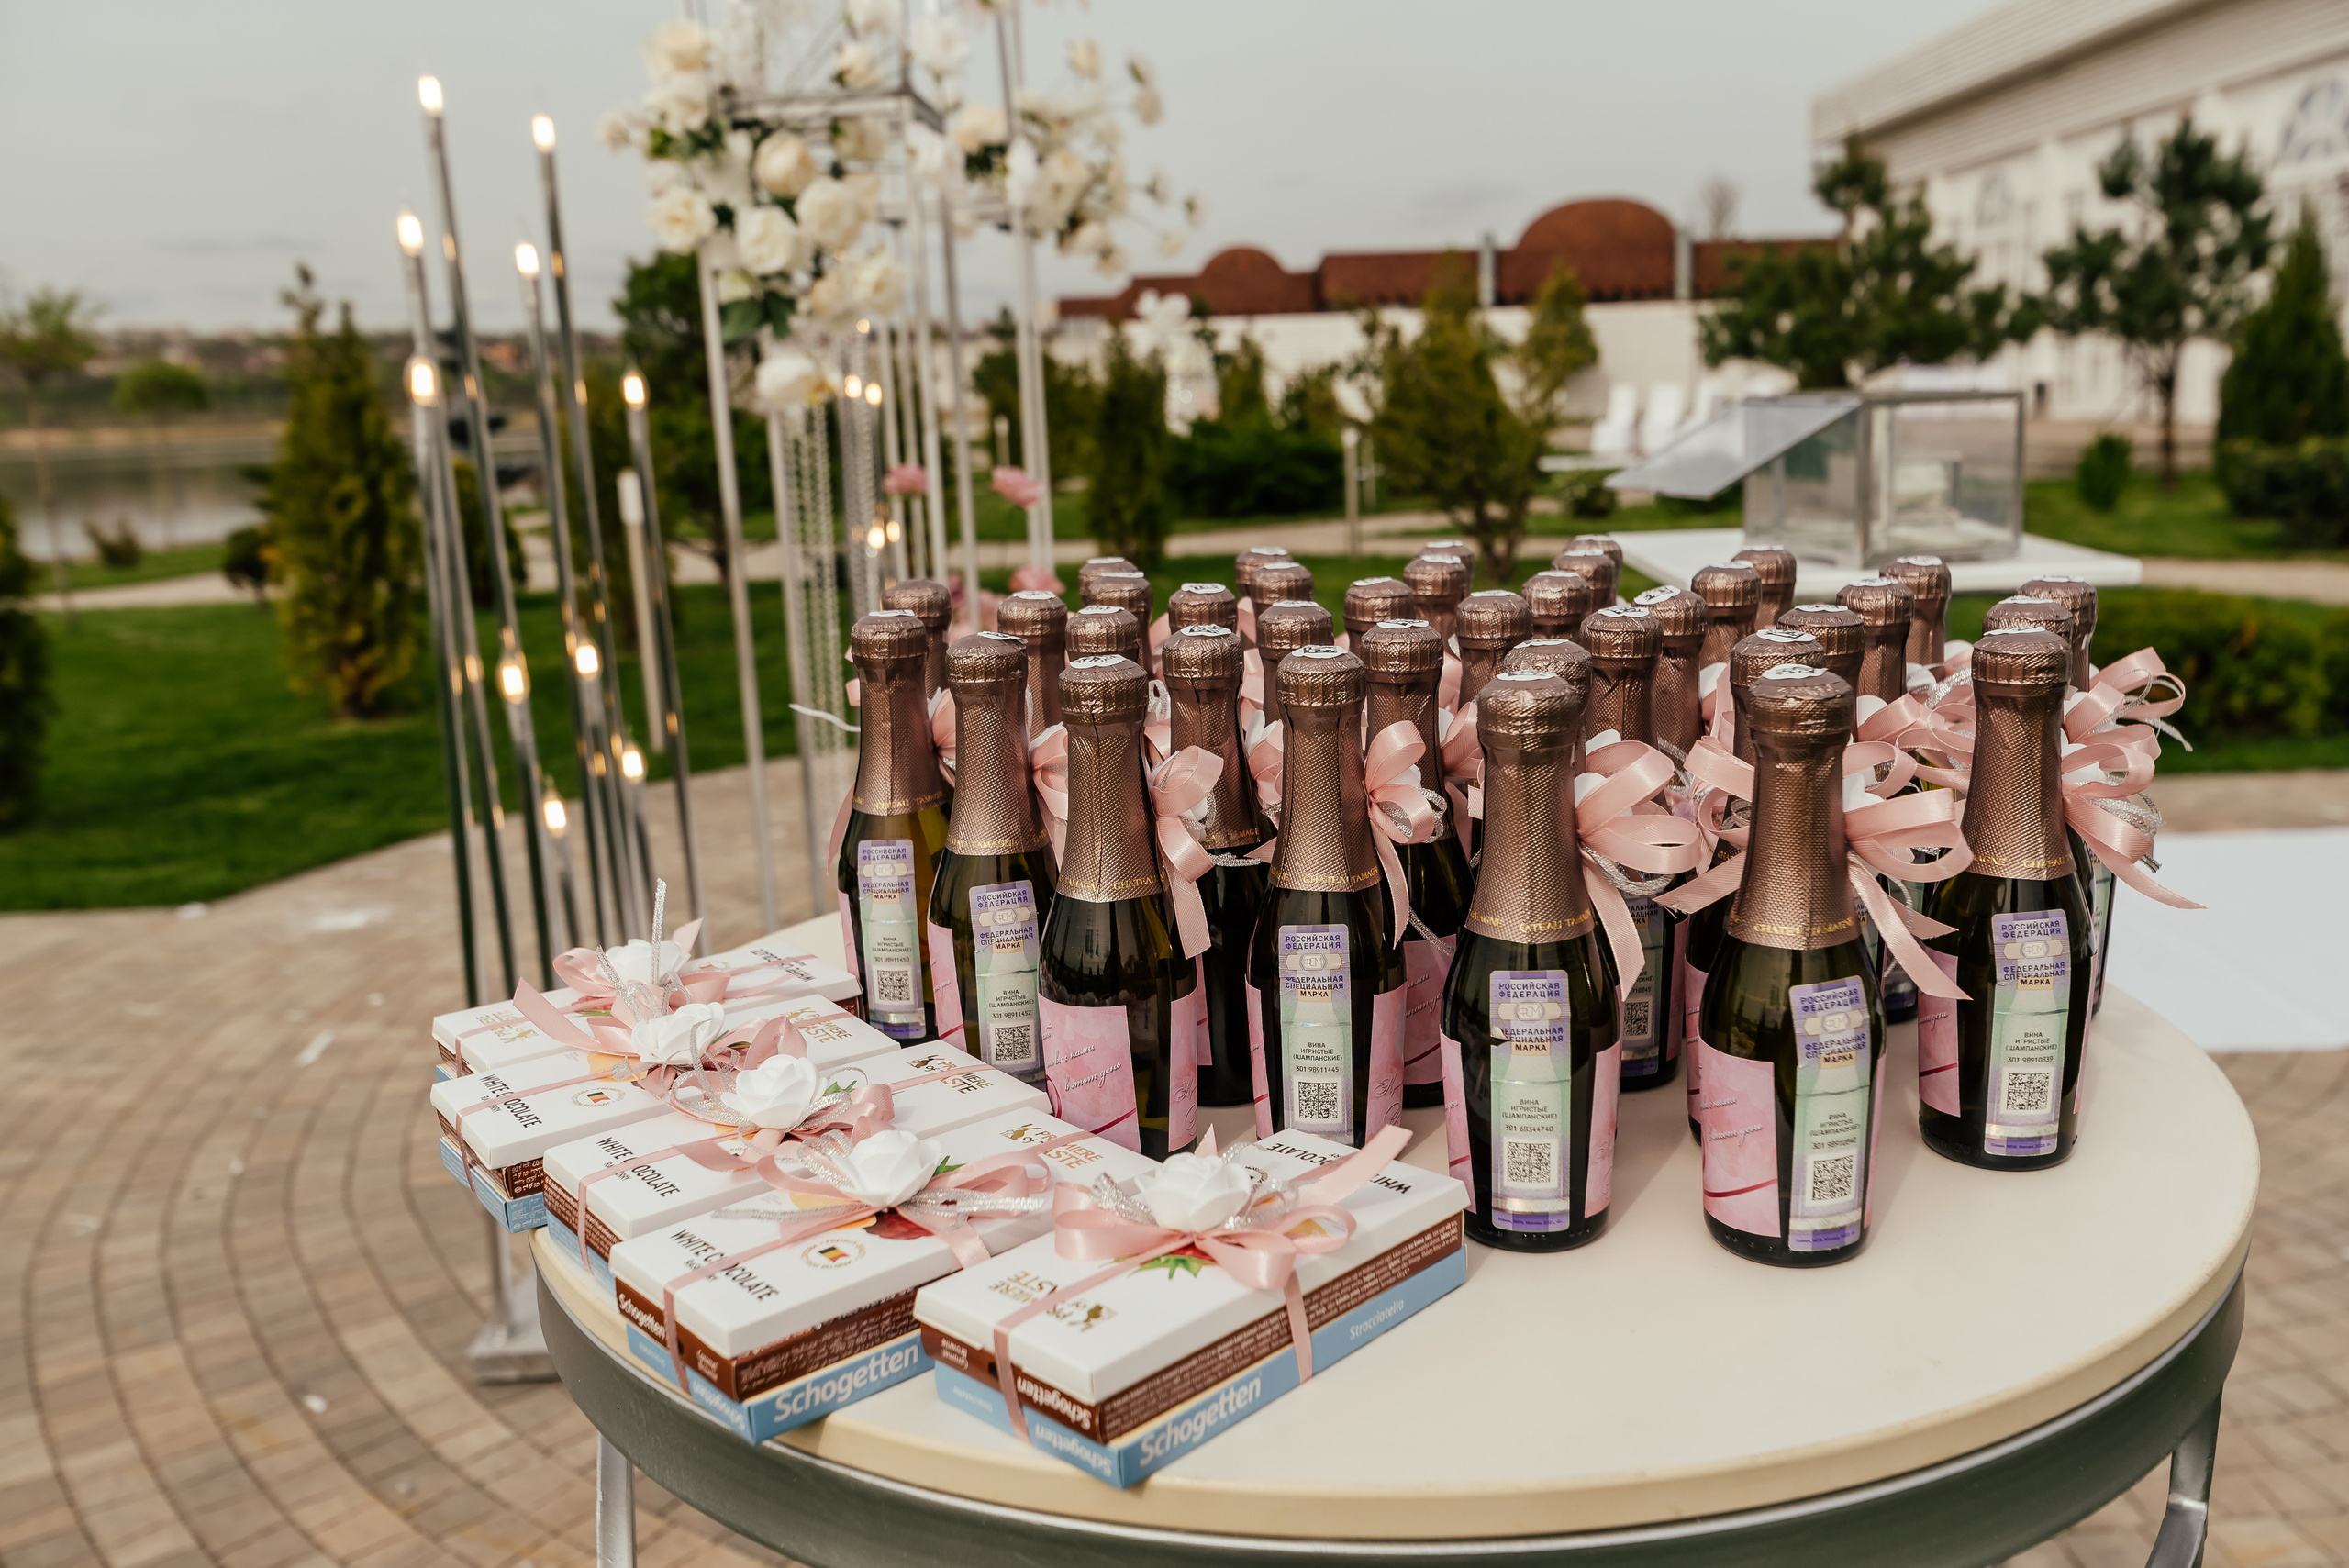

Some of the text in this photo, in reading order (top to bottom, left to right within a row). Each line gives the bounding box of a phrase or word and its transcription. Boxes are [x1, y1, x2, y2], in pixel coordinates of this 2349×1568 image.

[1114, 875, 1157, 890] CHATEAU
[977, 890, 1027, 902] РОССИЙСКАЯ
[978, 896, 1028, 908] ФЕДЕРАЦИЯ
[980, 927, 1032, 939] ФЕДЕРАЛЬНАЯ
[2002, 920, 2060, 931] РОССИЙСКАЯ
[2002, 928, 2061, 938] ФЕДЕРАЦИЯ
[981, 933, 1033, 945] СПЕЦИАЛЬНАЯ
[2004, 962, 2065, 973] ФЕДЕРАЛЬНАЯ
[2004, 969, 2065, 981] СПЕЦИАЛЬНАЯ
[1499, 982, 1560, 990] РОССИЙСКАЯ
[1499, 990, 1560, 998] ФЕДЕРАЦИЯ
[1800, 989, 1858, 1005] РОССИЙСКАЯ
[989, 999, 1034, 1008] (ШАМПАНСКИЕ)
[1802, 997, 1860, 1013] ФЕДЕРАЦИЯ
[798, 1024, 837, 1043] ASTE
[1509, 1035, 1564, 1043] ЕЦИАЛЬНАЯ
[1070, 1044, 1095, 1059] нами
[1824, 1054, 1853, 1063] МАРКА
[1098, 1062, 1122, 1088] день
[941, 1076, 978, 1094] ASTE
[479, 1073, 510, 1094] WHITE
[496, 1092, 542, 1128] COCOLATE
[1043, 1149, 1087, 1169] ASTE
[1267, 1143, 1334, 1166] OCOLATE
[596, 1136, 681, 1197] WHITE COCOLATE
[670, 1229, 716, 1256] WHITE
[704, 1251, 780, 1302] CCOLATE
[1008, 1271, 1058, 1296] ASTE
[1350, 1298, 1405, 1340] Stracciatella
[774, 1343, 918, 1422] Schogetten
[1017, 1376, 1092, 1430] Schogetten
[1140, 1377, 1261, 1466] Schogetten
